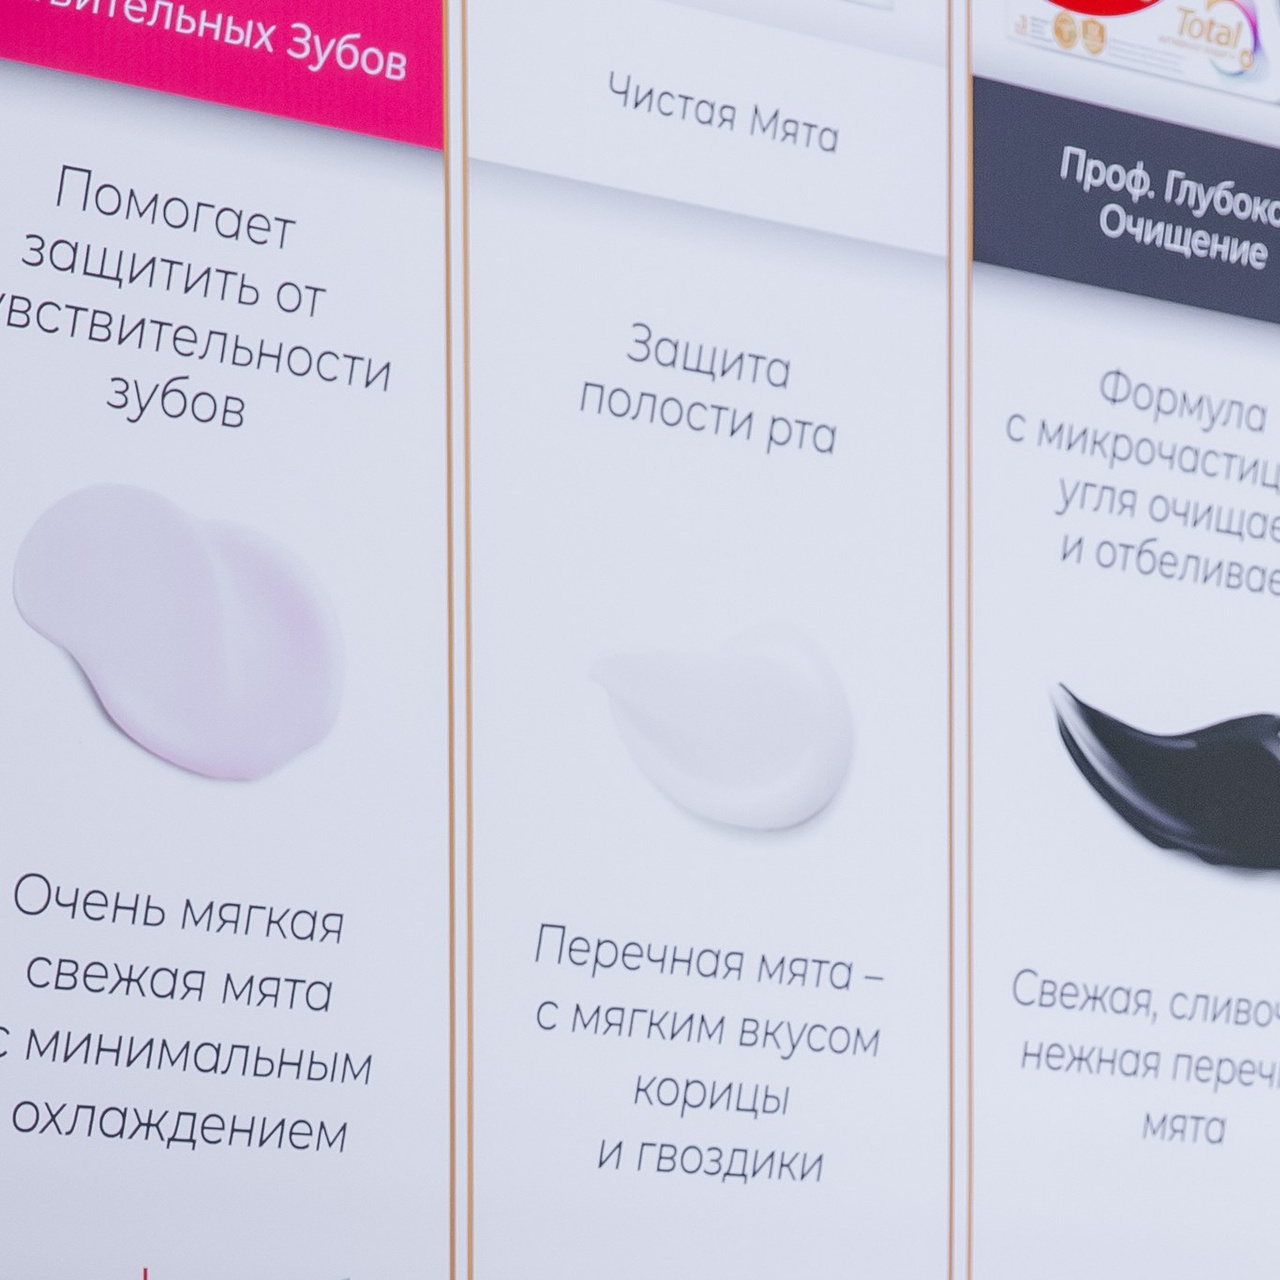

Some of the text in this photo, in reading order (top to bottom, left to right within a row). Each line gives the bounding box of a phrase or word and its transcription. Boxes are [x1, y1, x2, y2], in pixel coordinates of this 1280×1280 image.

[34, 0, 407, 81] ительных Зубов
[1177, 6, 1243, 47] Total
[608, 70, 839, 154] Чистая Мята
[1060, 145, 1155, 204] Проф.
[56, 164, 297, 249] Помогает
[1099, 202, 1269, 270] Очищение
[21, 233, 327, 318] защитить от
[0, 292, 391, 392] вствительности
[626, 321, 791, 389] Защита
[106, 374, 246, 429] зубов
[579, 380, 837, 455] полости рта
[1005, 412, 1027, 444] с
[1099, 367, 1268, 434] Формула
[1054, 478, 1138, 518] угля
[1060, 534, 1085, 564] и
[13, 872, 344, 944] Очень мягкая
[26, 955, 333, 1013] свежая мята
[534, 922, 745, 981] Перечная
[757, 953, 854, 991] мята
[1012, 967, 1158, 1023] Свежая,
[25, 1028, 373, 1085] минимальным
[535, 1000, 881, 1061] с мягким вкусом
[1020, 1040, 1162, 1079] нежная
[11, 1100, 348, 1153] охлаждением
[633, 1075, 790, 1120] корицы
[1142, 1112, 1227, 1146] мята
[597, 1139, 824, 1185] и гвоздики
